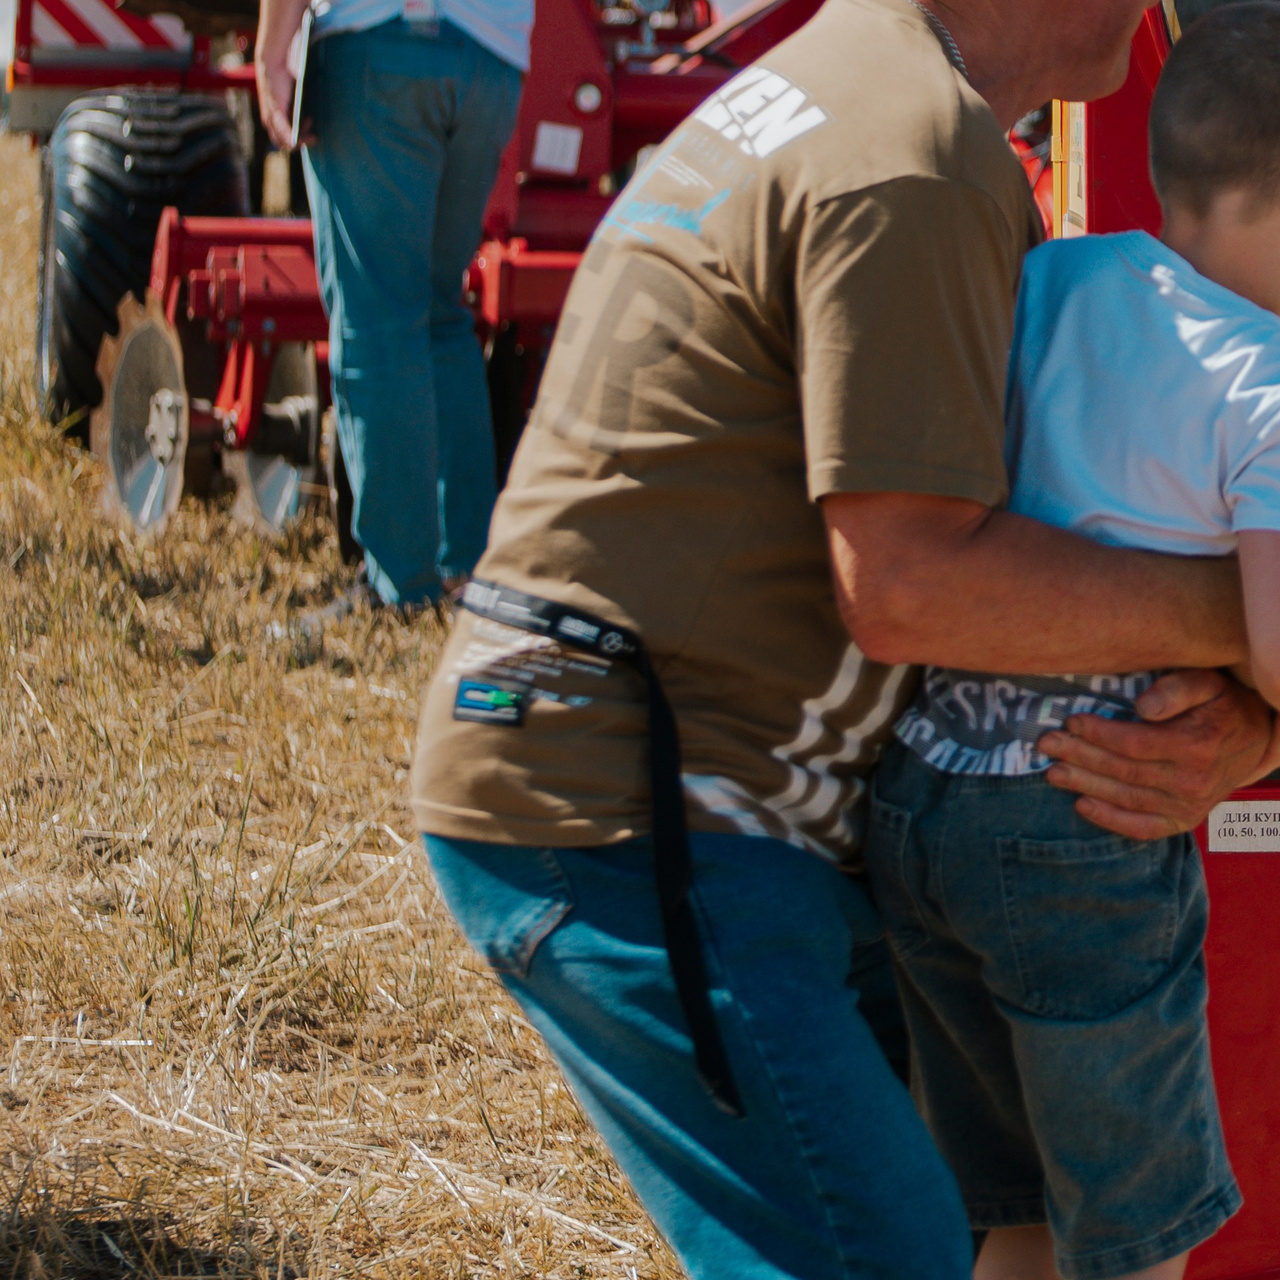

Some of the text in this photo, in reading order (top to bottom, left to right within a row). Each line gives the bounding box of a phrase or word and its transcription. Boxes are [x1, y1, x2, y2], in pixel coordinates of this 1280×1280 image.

[1223, 812, 1251, 824] ДЛЯ
[1217, 827, 1238, 838] (10,
[1240, 827, 1257, 838] 50,
